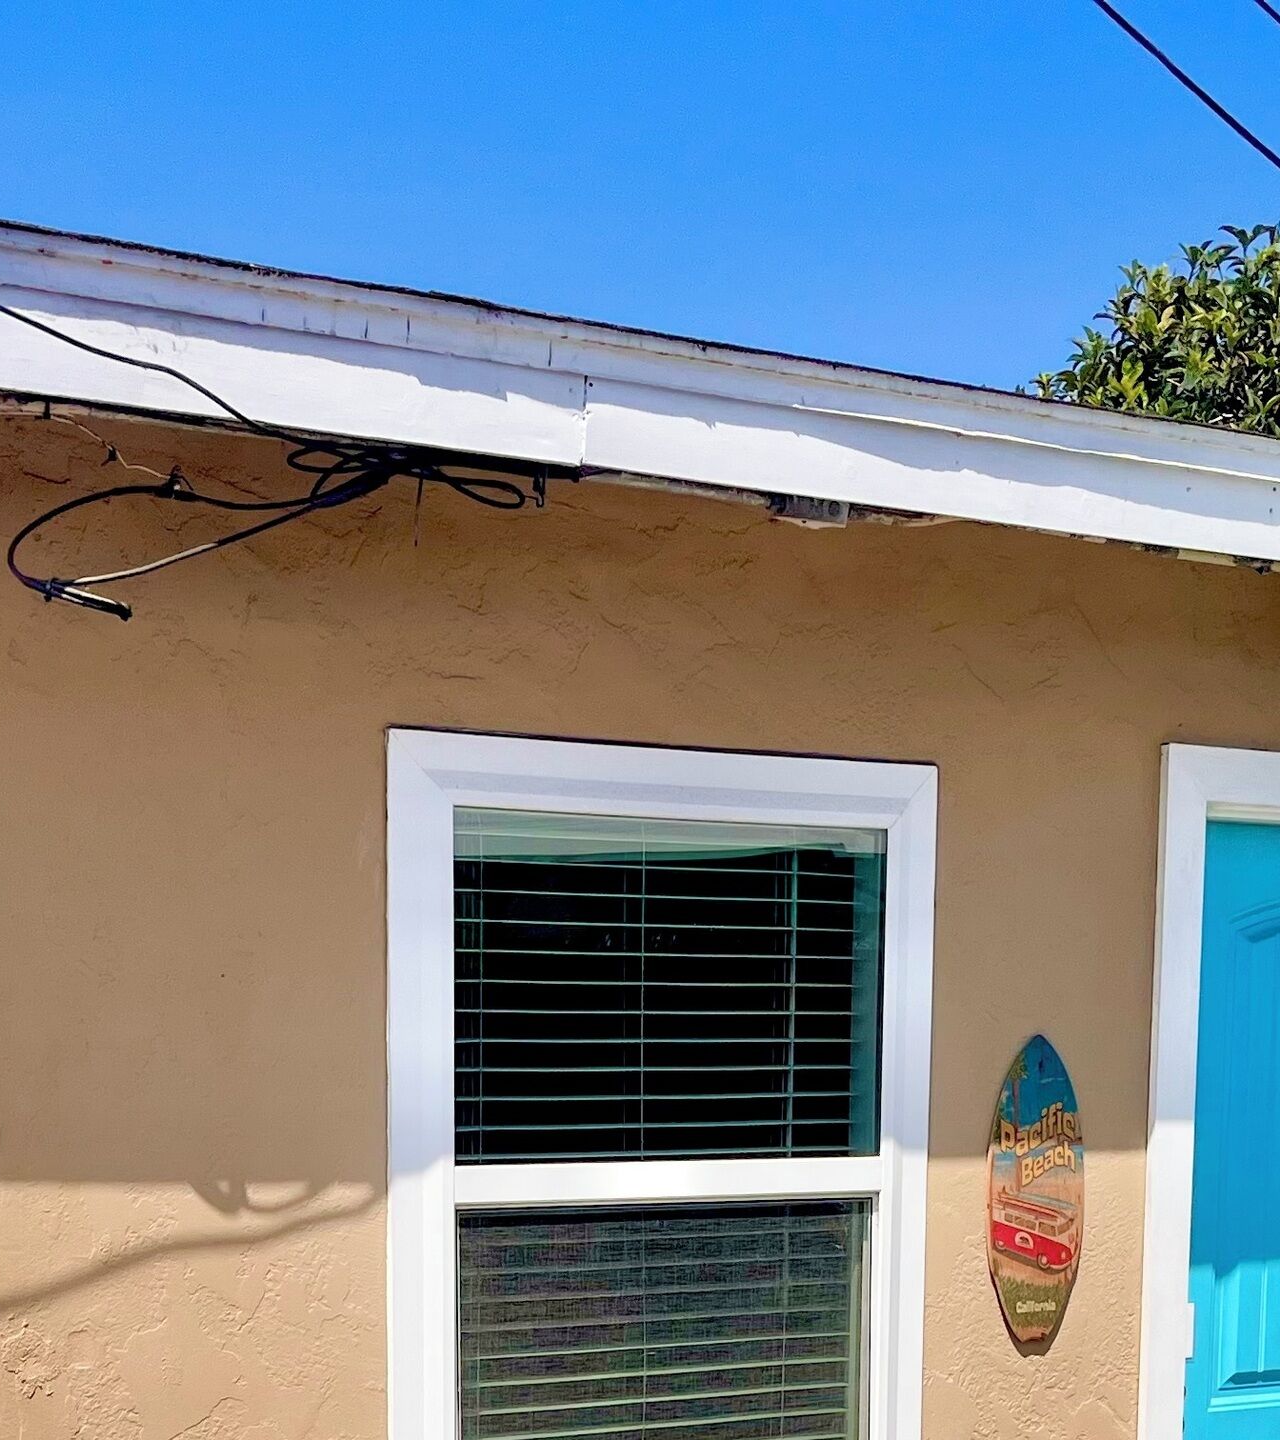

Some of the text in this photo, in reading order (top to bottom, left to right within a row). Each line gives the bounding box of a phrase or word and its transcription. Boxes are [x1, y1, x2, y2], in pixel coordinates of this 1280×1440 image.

[1000, 1101, 1076, 1156] Pacific
[1021, 1140, 1076, 1188] Beach
[1016, 1299, 1057, 1313] California
